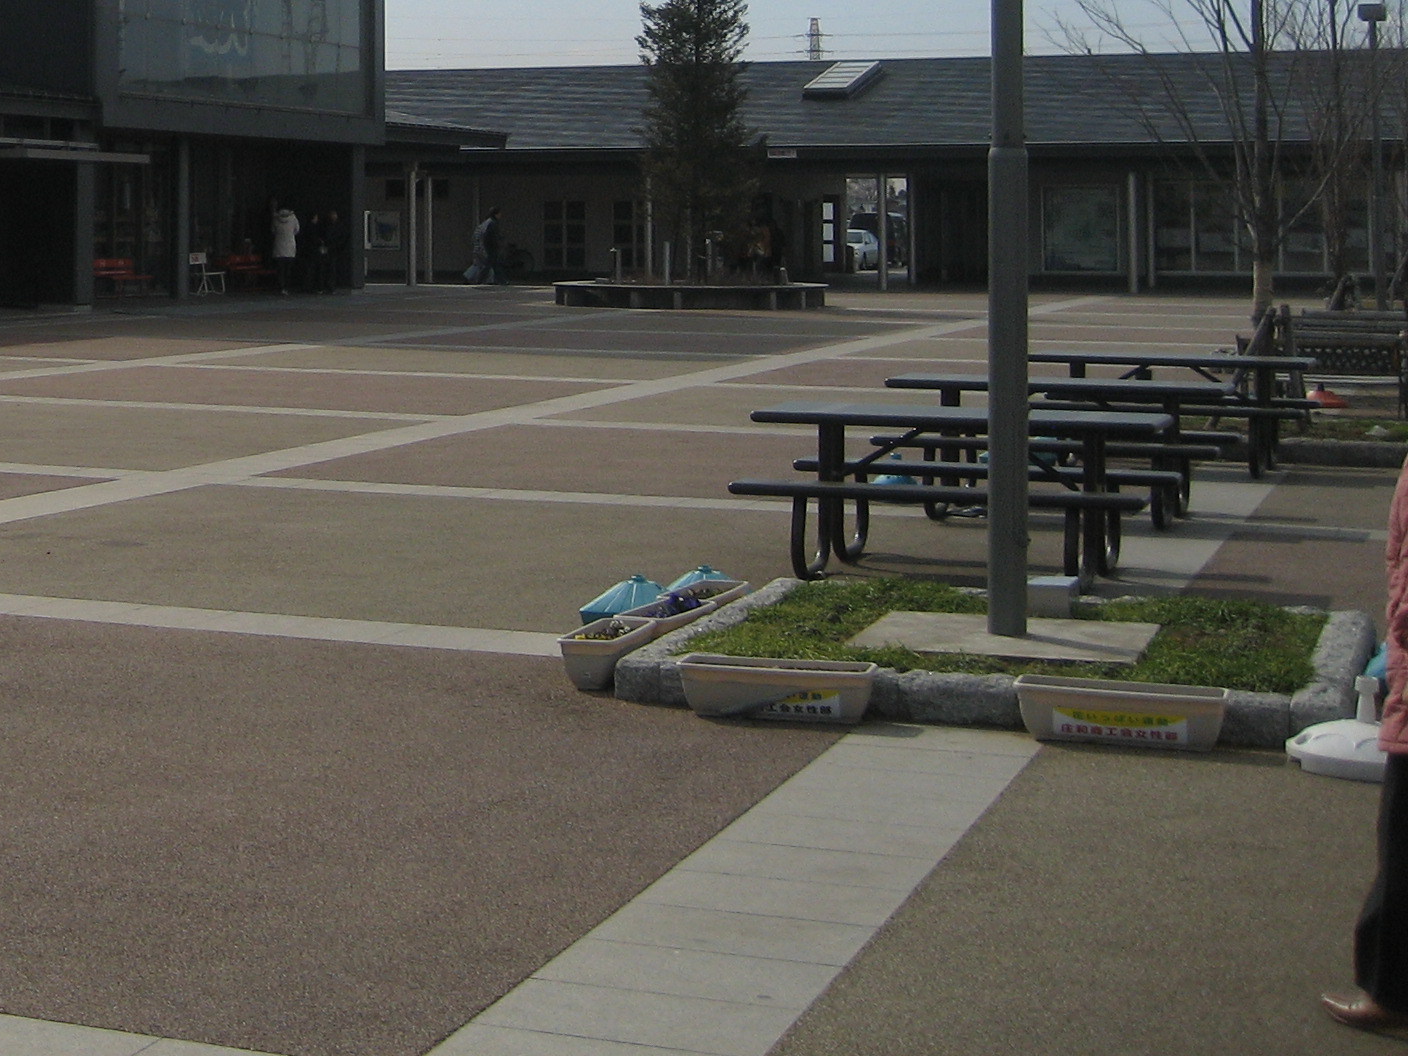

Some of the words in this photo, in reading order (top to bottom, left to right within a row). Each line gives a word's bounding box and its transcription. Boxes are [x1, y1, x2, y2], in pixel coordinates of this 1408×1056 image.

[1061, 724, 1178, 740] 庄和商工会女性部
